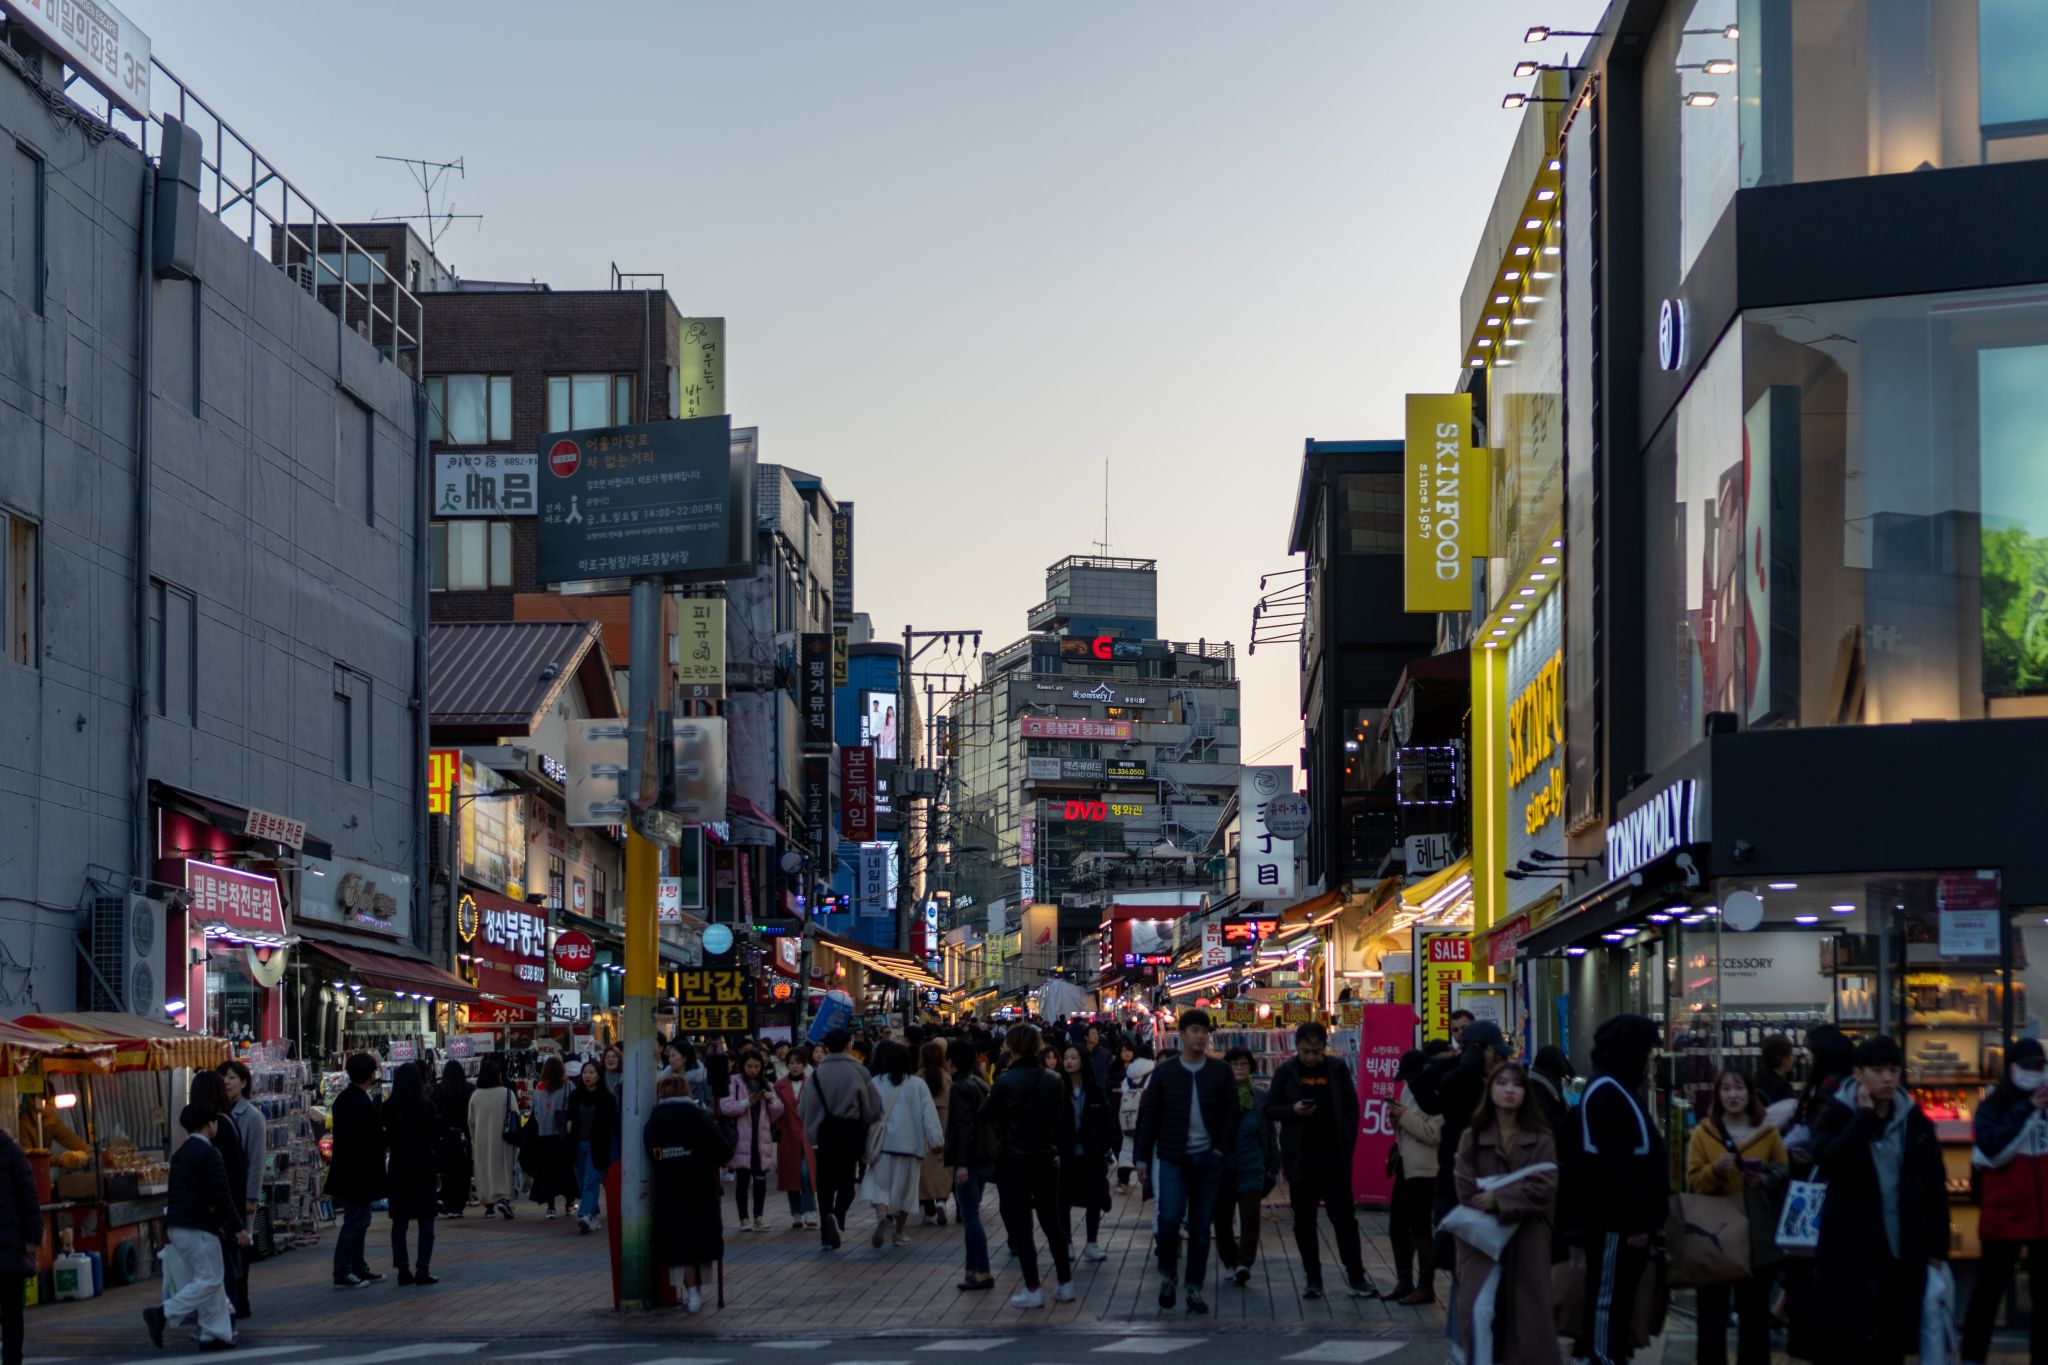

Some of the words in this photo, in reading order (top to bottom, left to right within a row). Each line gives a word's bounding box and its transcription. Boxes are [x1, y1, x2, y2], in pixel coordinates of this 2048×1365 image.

[45, 0, 119, 78] 비밀의화원
[123, 51, 147, 96] 3F
[586, 433, 649, 449] 어울마당로
[586, 457, 598, 470] 차
[466, 473, 533, 510] 담배
[1419, 463, 1429, 504] since
[1436, 422, 1460, 580] SKINFOOD
[1419, 508, 1432, 539] 1957
[681, 665, 720, 678] 프렌즈
[693, 685, 709, 697] B1
[847, 750, 868, 827] 보드게임
[1064, 800, 1107, 821] DVD
[1111, 803, 1143, 816] 영화관
[249, 811, 303, 845] 필름부착전문
[1606, 779, 1683, 882] TONYMOLY
[1415, 835, 1449, 868] 헤나
[194, 874, 272, 923] 필름부착전문점
[485, 908, 546, 958] 성신부동산
[555, 944, 592, 959] 부동산
[1434, 940, 1466, 960] SALE
[682, 970, 744, 1002] 반값
[682, 1006, 744, 1029] 방탈출
[393, 1041, 415, 1049] SALE
[393, 1049, 415, 1057] 5000
